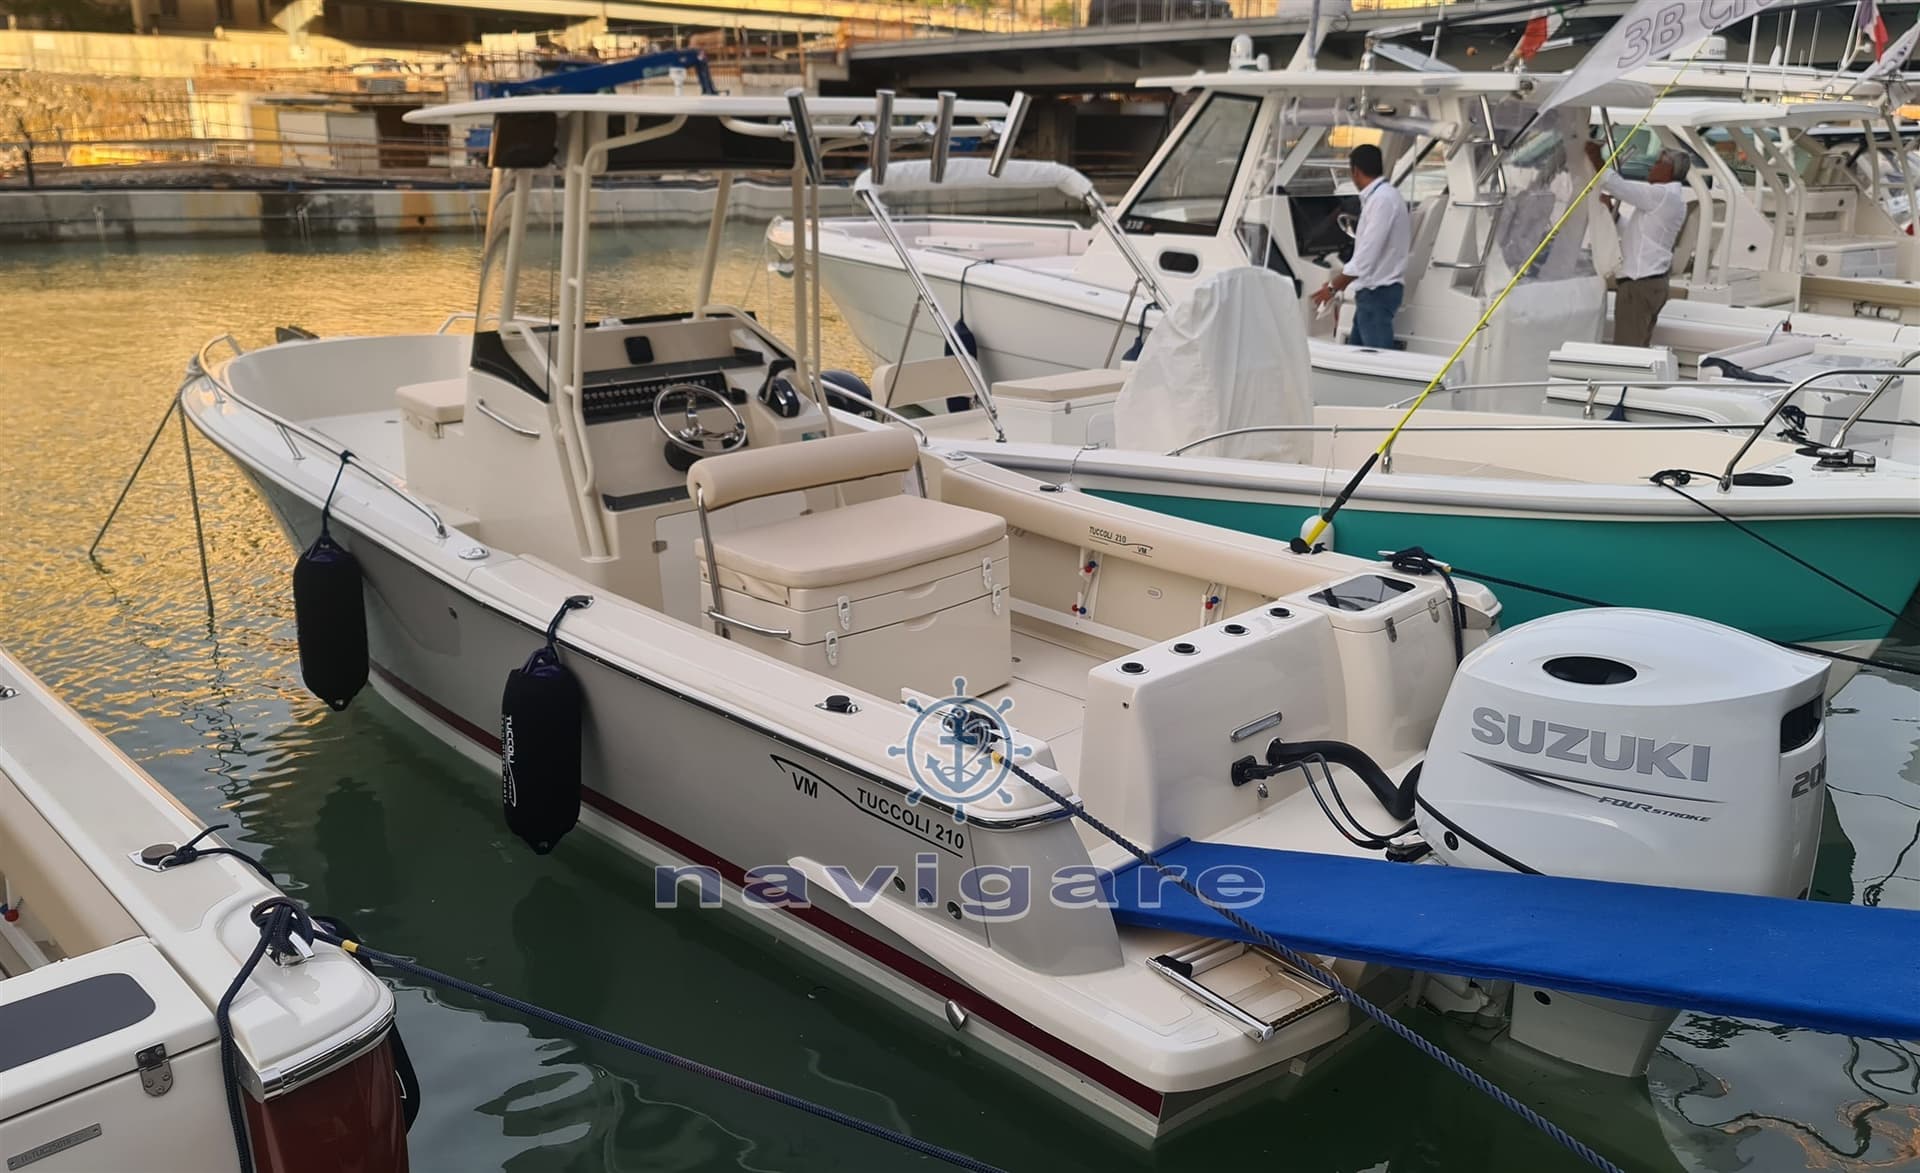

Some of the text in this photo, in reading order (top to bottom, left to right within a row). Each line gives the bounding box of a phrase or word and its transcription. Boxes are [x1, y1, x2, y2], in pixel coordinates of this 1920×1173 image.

[1617, 2, 1686, 69] 3B
[1089, 526, 1127, 543] TUCCOLI 210
[1471, 706, 1711, 783] SUZUKI
[792, 772, 818, 799] VM
[857, 787, 964, 849] TUCCOLI 210
